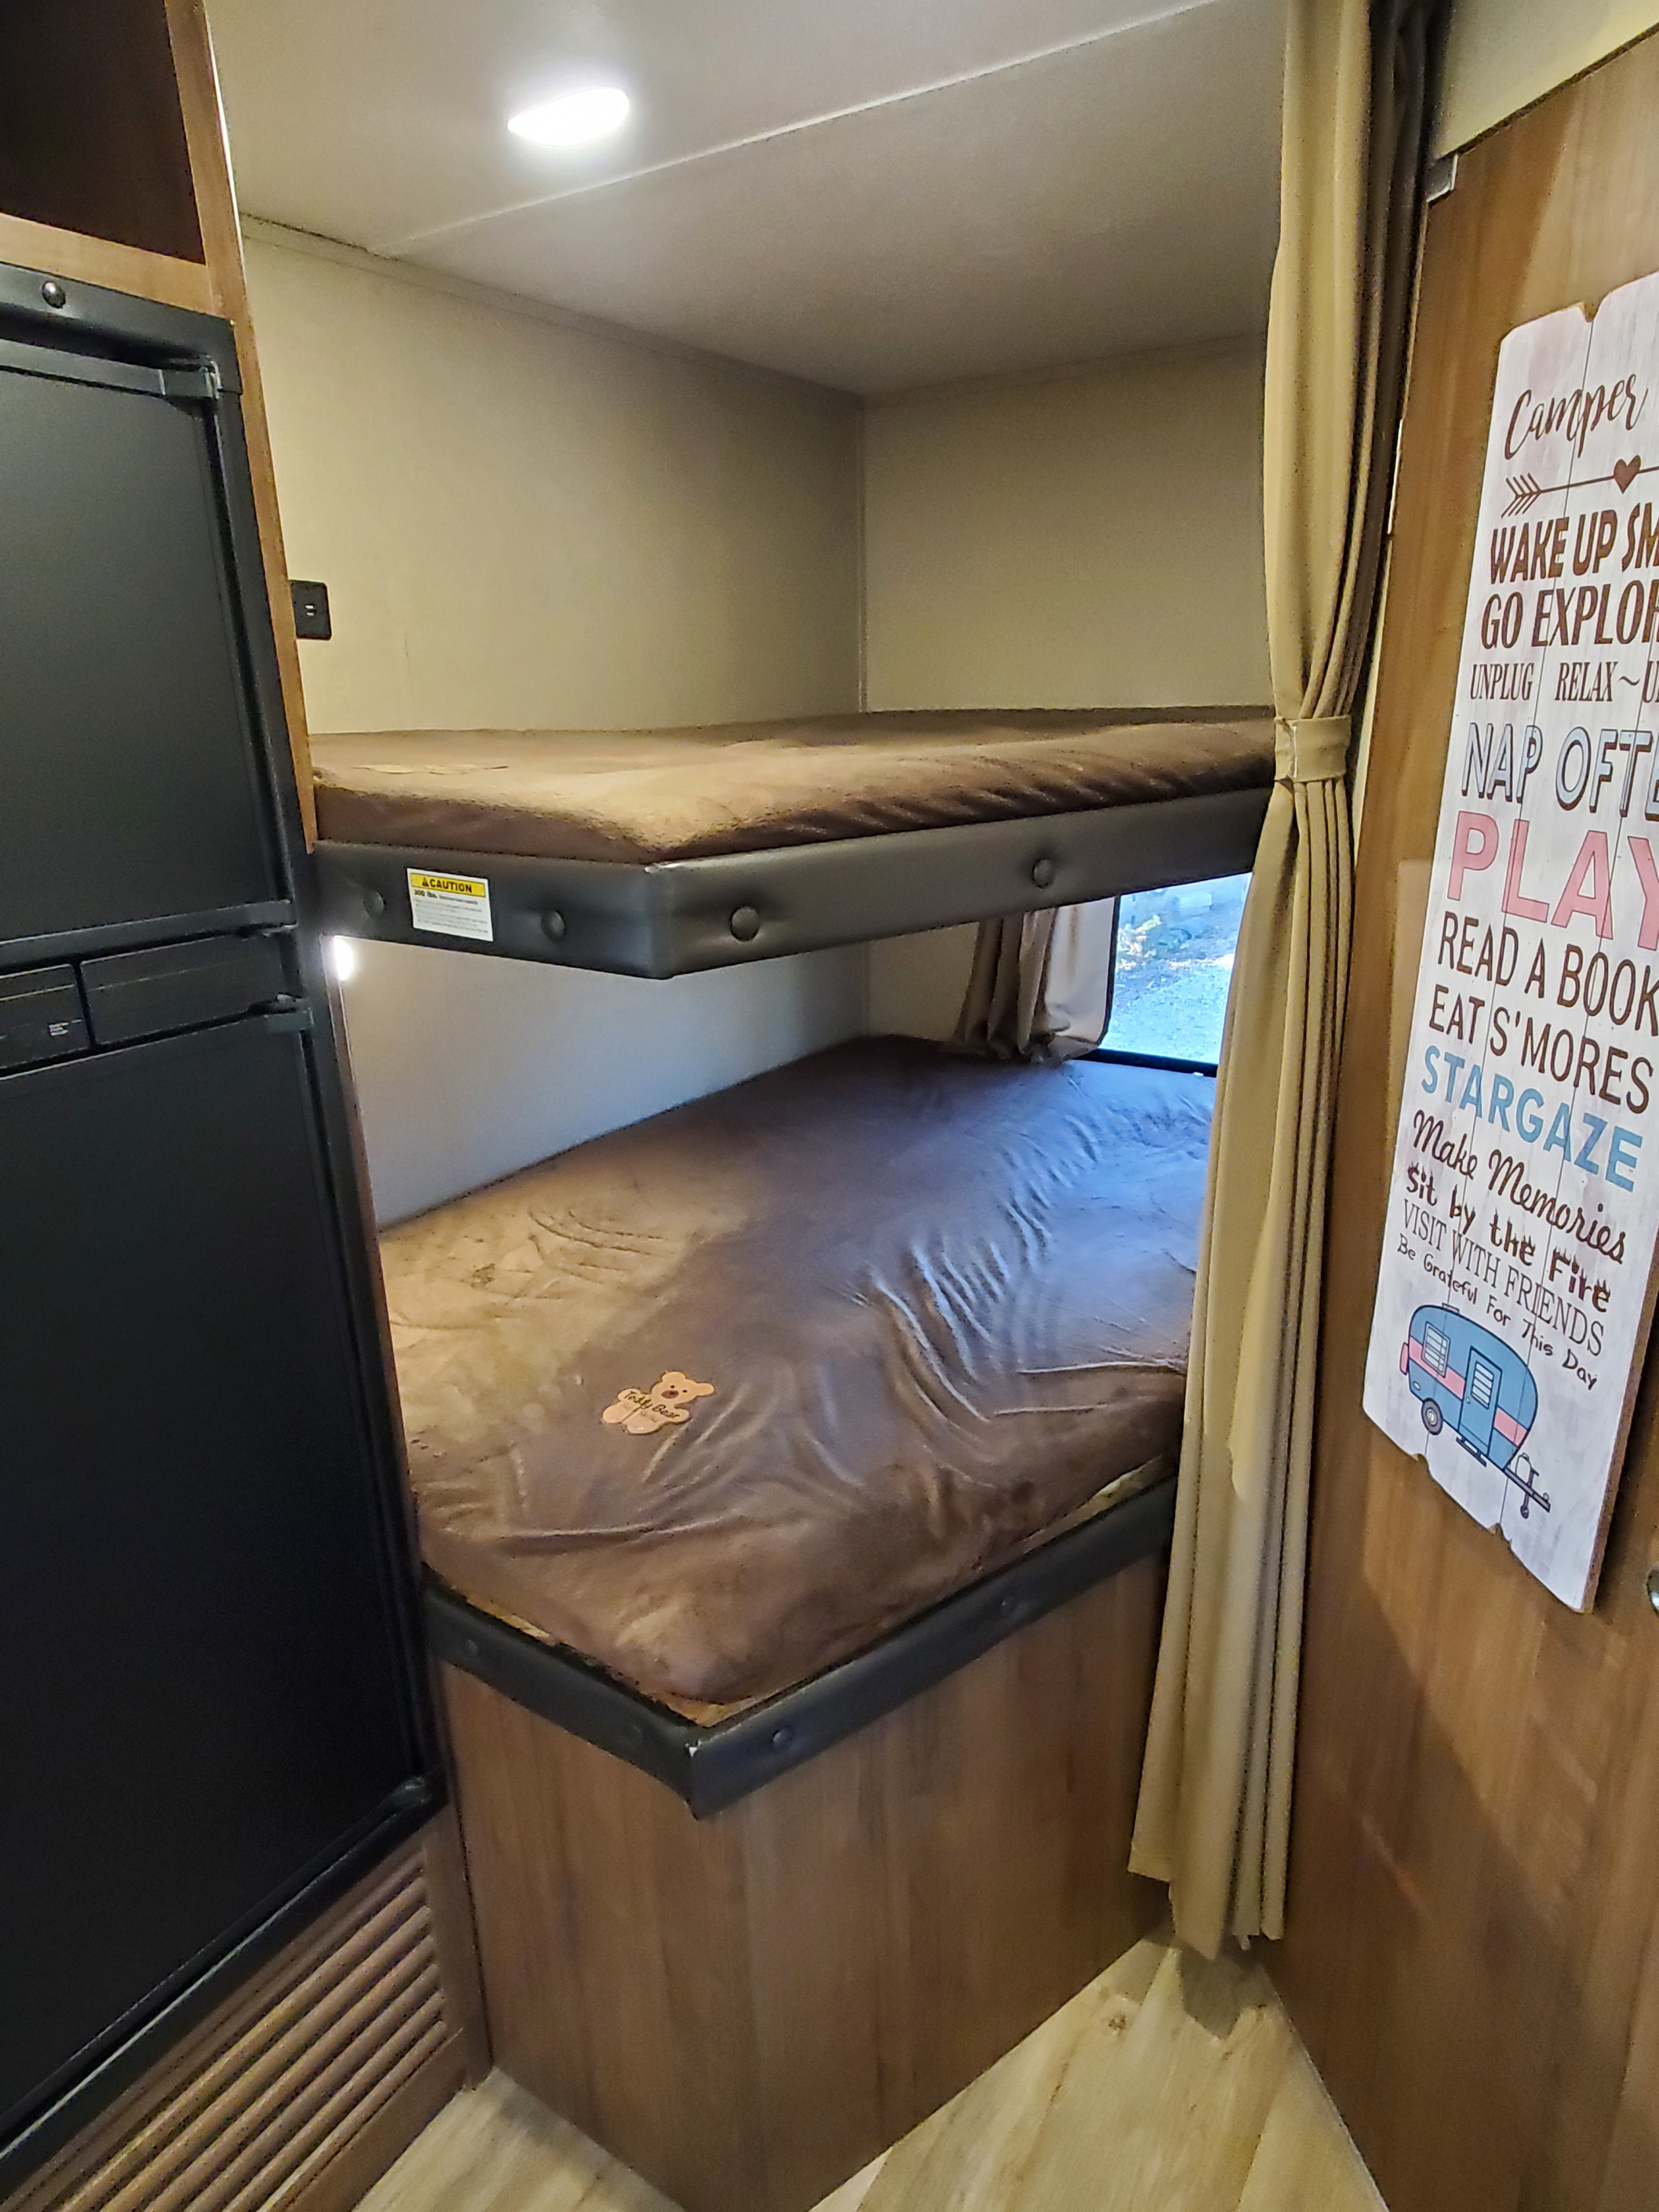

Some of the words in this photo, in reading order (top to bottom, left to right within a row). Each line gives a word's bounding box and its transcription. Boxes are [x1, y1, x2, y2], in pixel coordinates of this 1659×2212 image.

[1504, 374, 1648, 460] Camper
[1490, 517, 1569, 585] WAKE
[1573, 509, 1618, 576] UP
[1470, 662, 1534, 700] UNPLUG
[1481, 591, 1523, 649] GO
[1462, 722, 1543, 804] NAP
[430, 879, 472, 893] CAUTION
[1447, 811, 1659, 951] PLAY
[1438, 911, 1519, 986] READ
[1524, 937, 1545, 998] A
[1557, 943, 1659, 1036] BOOK
[1429, 984, 1485, 1044] EAT
[1490, 1006, 1653, 1114] S'MORES
[1421, 1045, 1643, 1193] STARGAZE
[1406, 1162, 1437, 1206] Sit
[1449, 1184, 1476, 1235] by
[1490, 1207, 1536, 1266] the
[1548, 1246, 1611, 1312] Fire
[1413, 1109, 1478, 1180] Make
[1488, 1149, 1626, 1264] Memories
[1397, 1234, 1416, 1260] Be
[1423, 1253, 1478, 1305] Grateful
[1486, 1295, 1511, 1327] For
[1521, 1318, 1553, 1357] This
[1562, 1349, 1598, 1390] Day
[1404, 1198, 1447, 1251] VISIT
[1452, 1229, 1500, 1288] WITH
[1504, 1265, 1604, 1357] FRIENDS
[624, 1391, 653, 1410] Teddy
[651, 1404, 680, 1419] Bear
